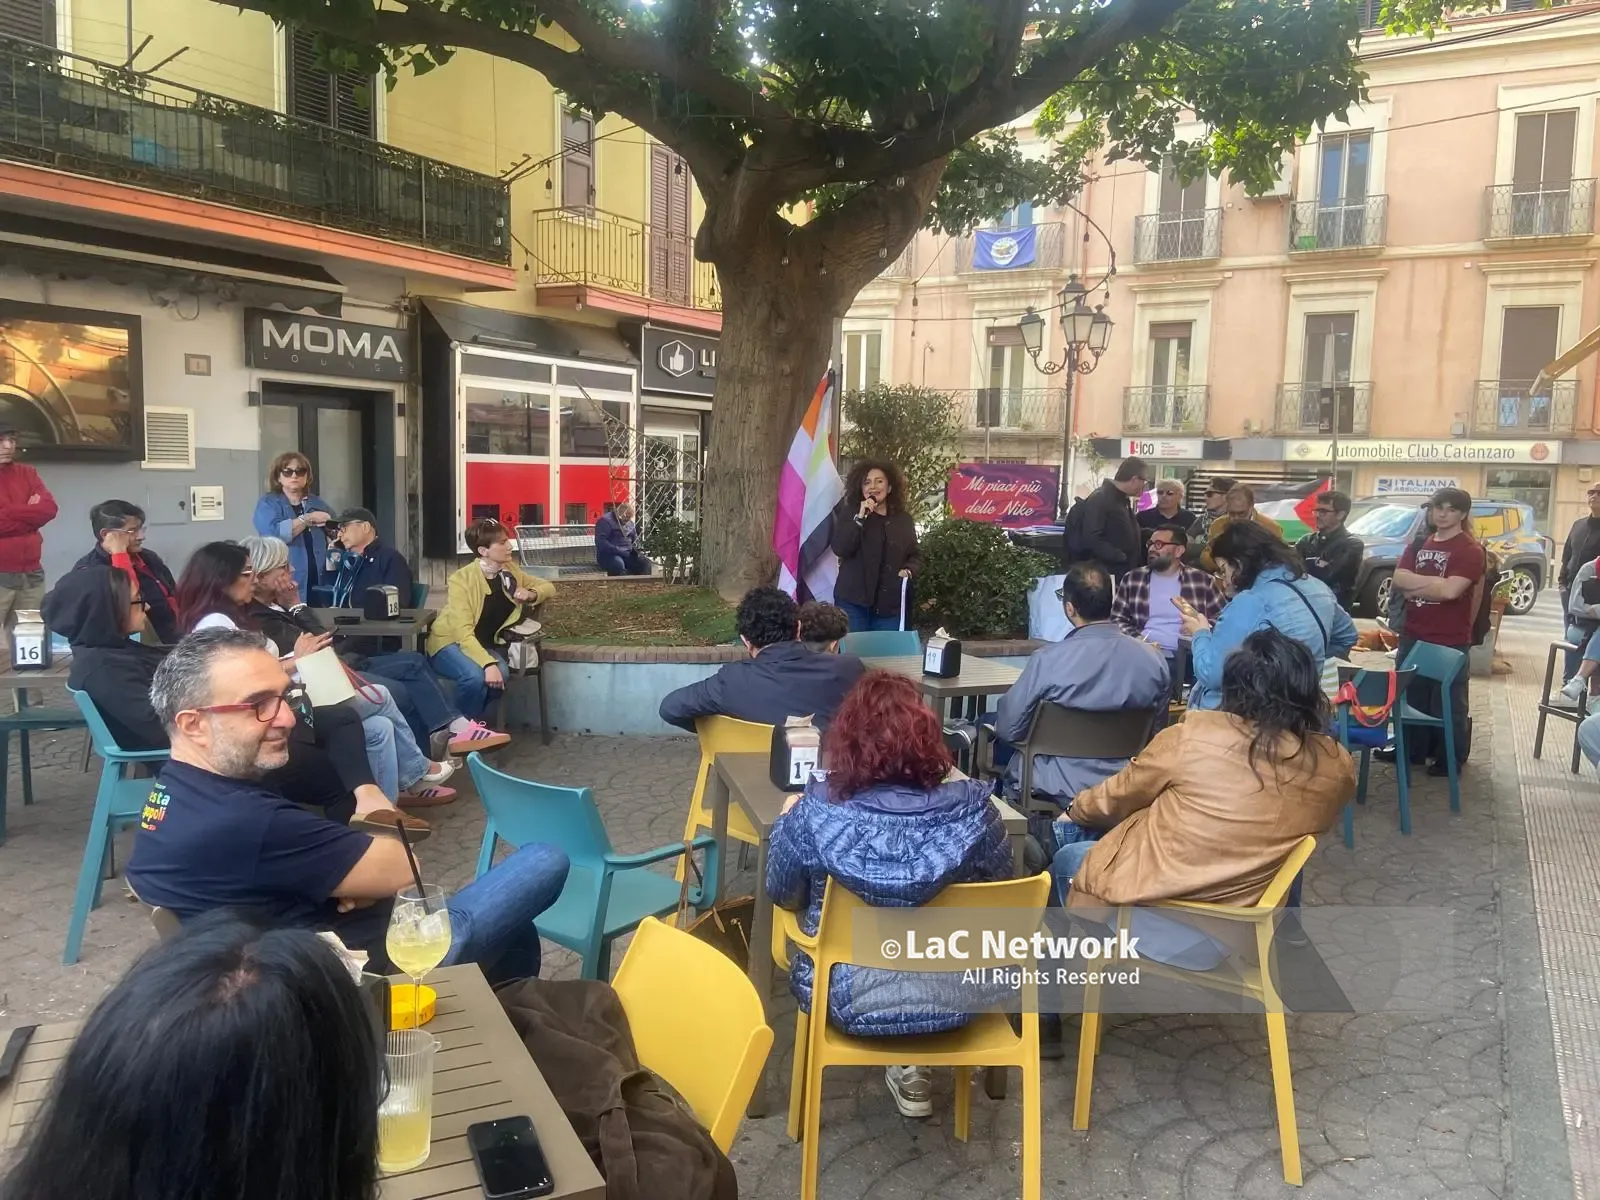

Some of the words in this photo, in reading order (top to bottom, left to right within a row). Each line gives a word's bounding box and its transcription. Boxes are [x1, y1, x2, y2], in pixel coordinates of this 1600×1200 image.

[262, 318, 403, 362] MOMA
[263, 352, 404, 374] LOUNGE
[702, 348, 716, 367] LI
[1326, 443, 1403, 458] Automobile
[1407, 443, 1439, 458] Club
[1443, 443, 1515, 459] Catanzaro
[962, 475, 985, 491] Mi
[982, 479, 1018, 496] piaci
[1015, 479, 1042, 497] più
[1395, 479, 1456, 488] ITALIANA
[965, 499, 997, 515] delle
[998, 500, 1034, 517] Nike
[389, 602, 399, 614] 18
[19, 646, 40, 661] 16
[794, 761, 815, 780] 17
